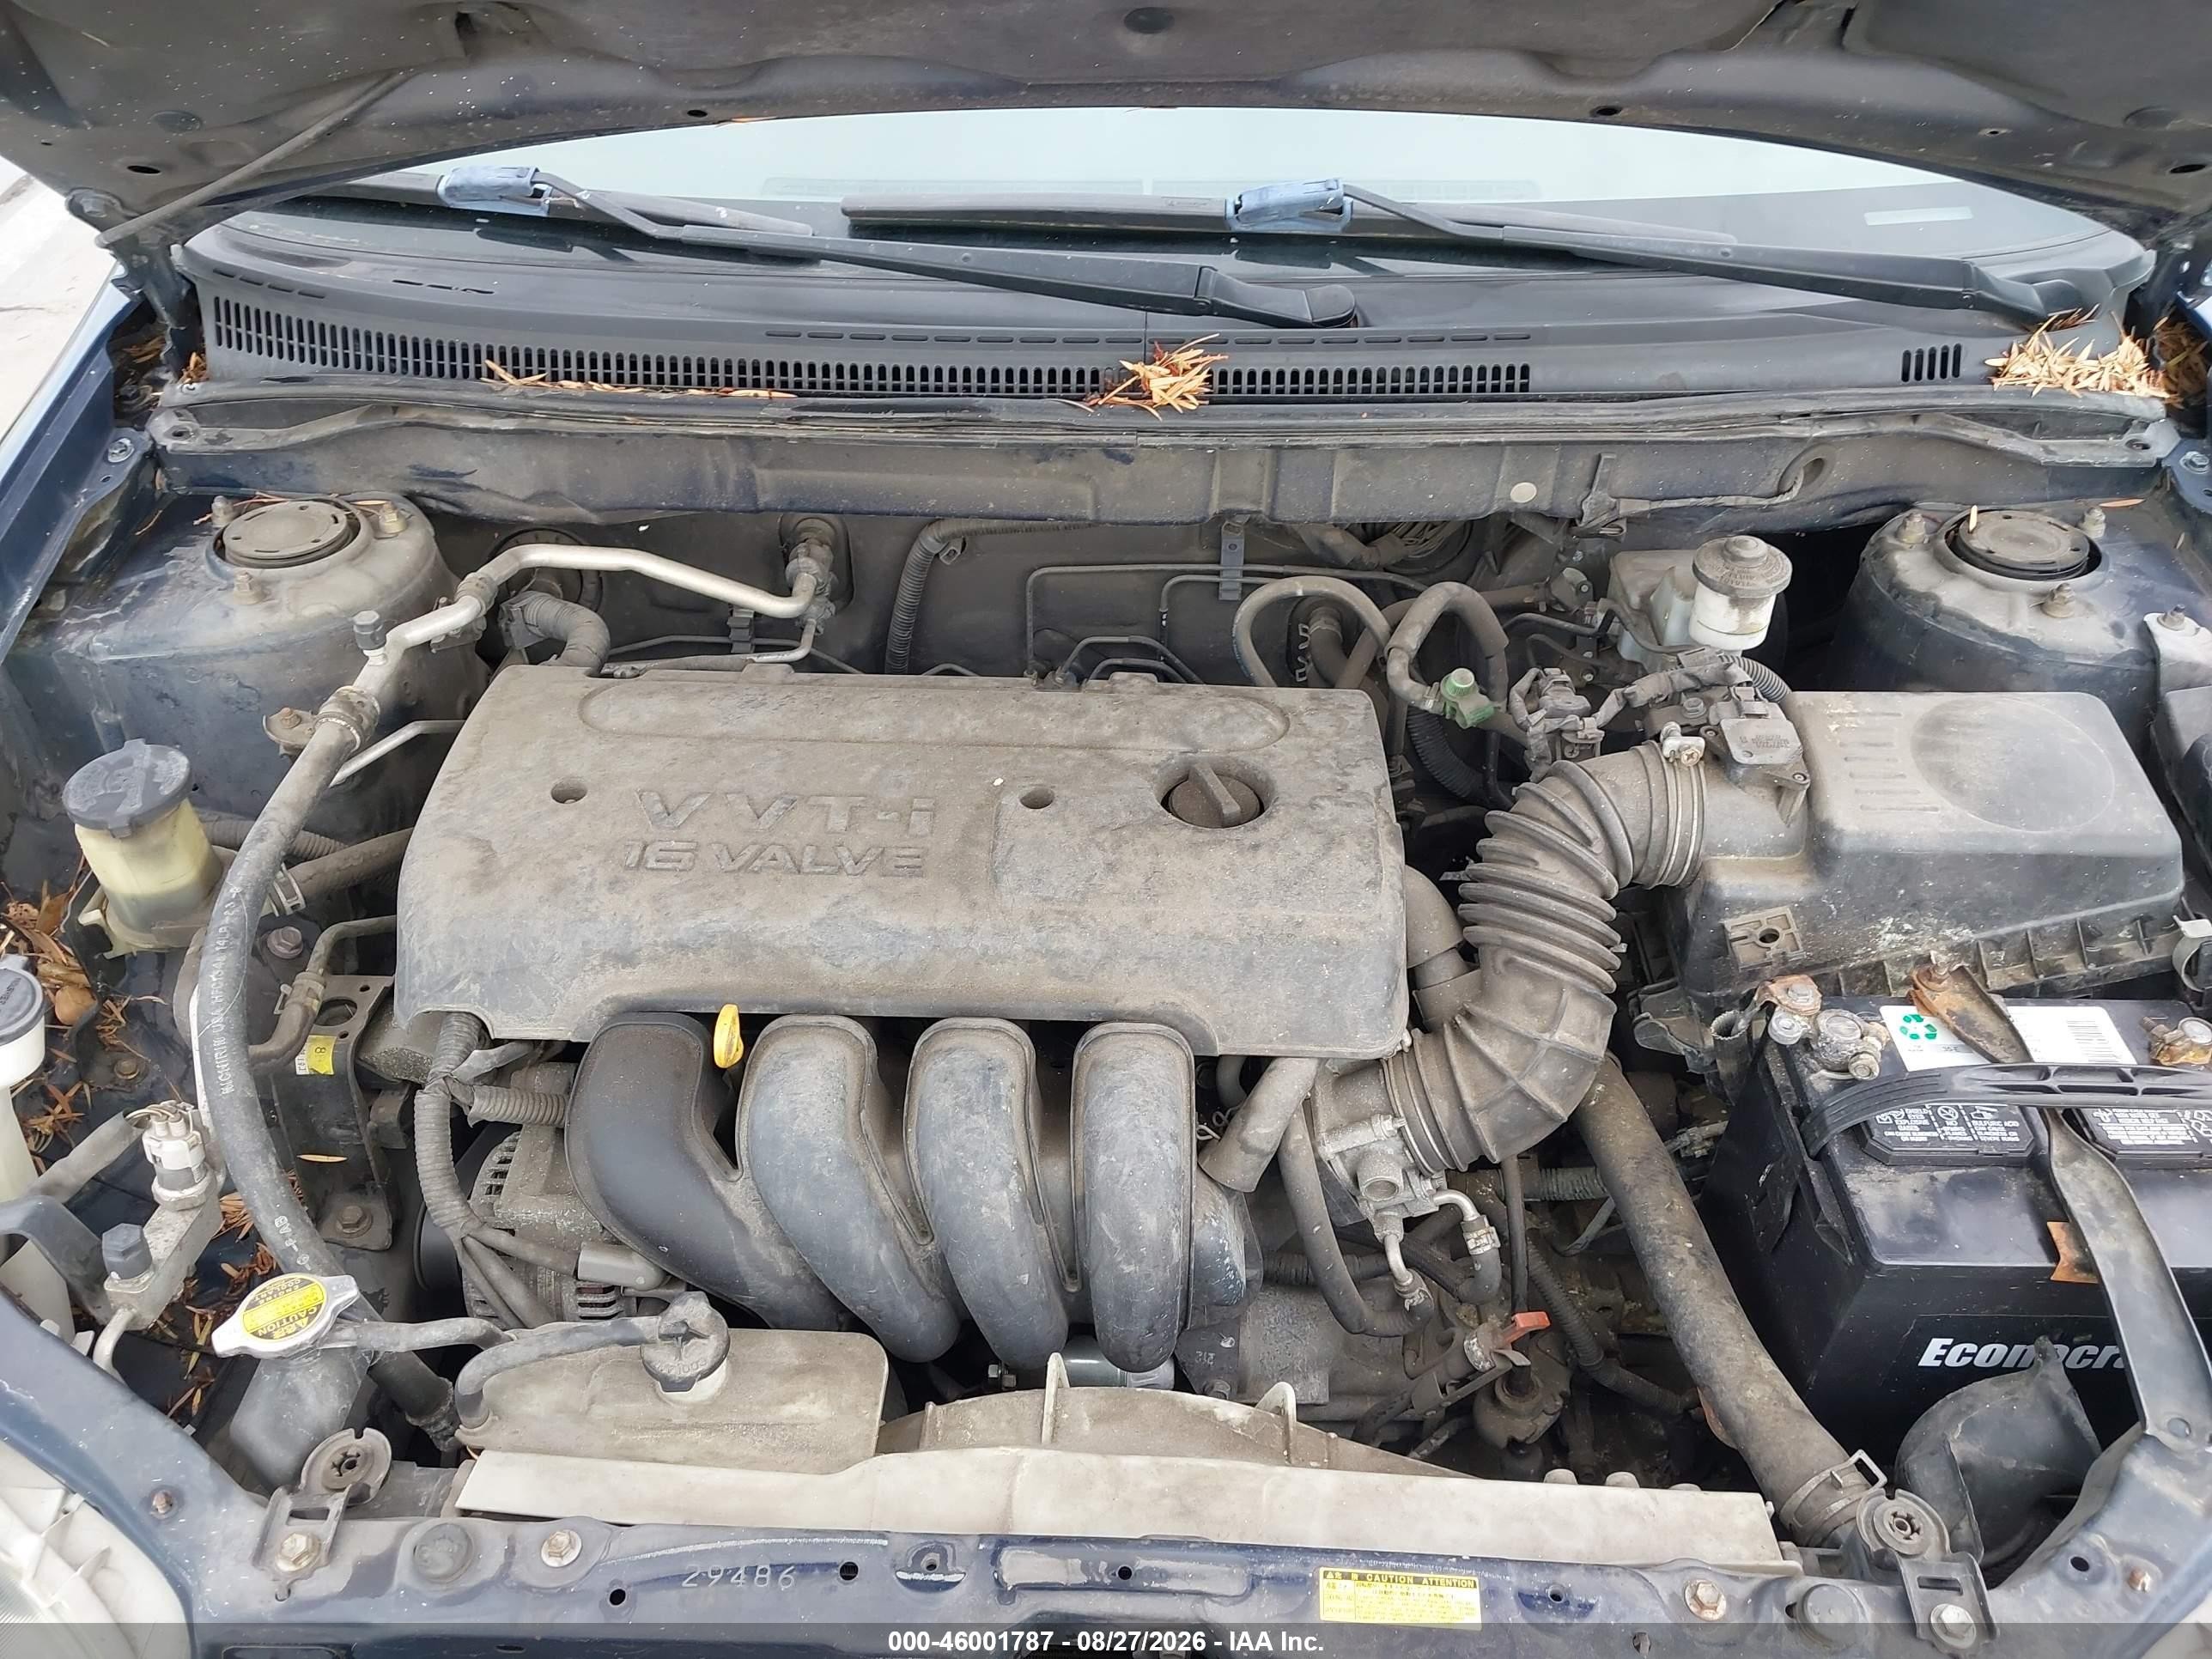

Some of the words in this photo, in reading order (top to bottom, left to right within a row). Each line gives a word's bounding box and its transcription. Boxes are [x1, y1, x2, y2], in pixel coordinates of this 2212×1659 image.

[623, 840, 700, 872] 16
[711, 843, 925, 877] VALVE
[253, 1279, 301, 1301] COOLANT
[258, 1285, 300, 1305] ENGINE
[258, 1308, 317, 1337] CAUTION
[1917, 1338, 2125, 1369] Econcr
[681, 1564, 796, 1589] 29486
[1366, 1573, 1414, 1584] CAUTION
[1421, 1577, 1474, 1588] ATTENTION
